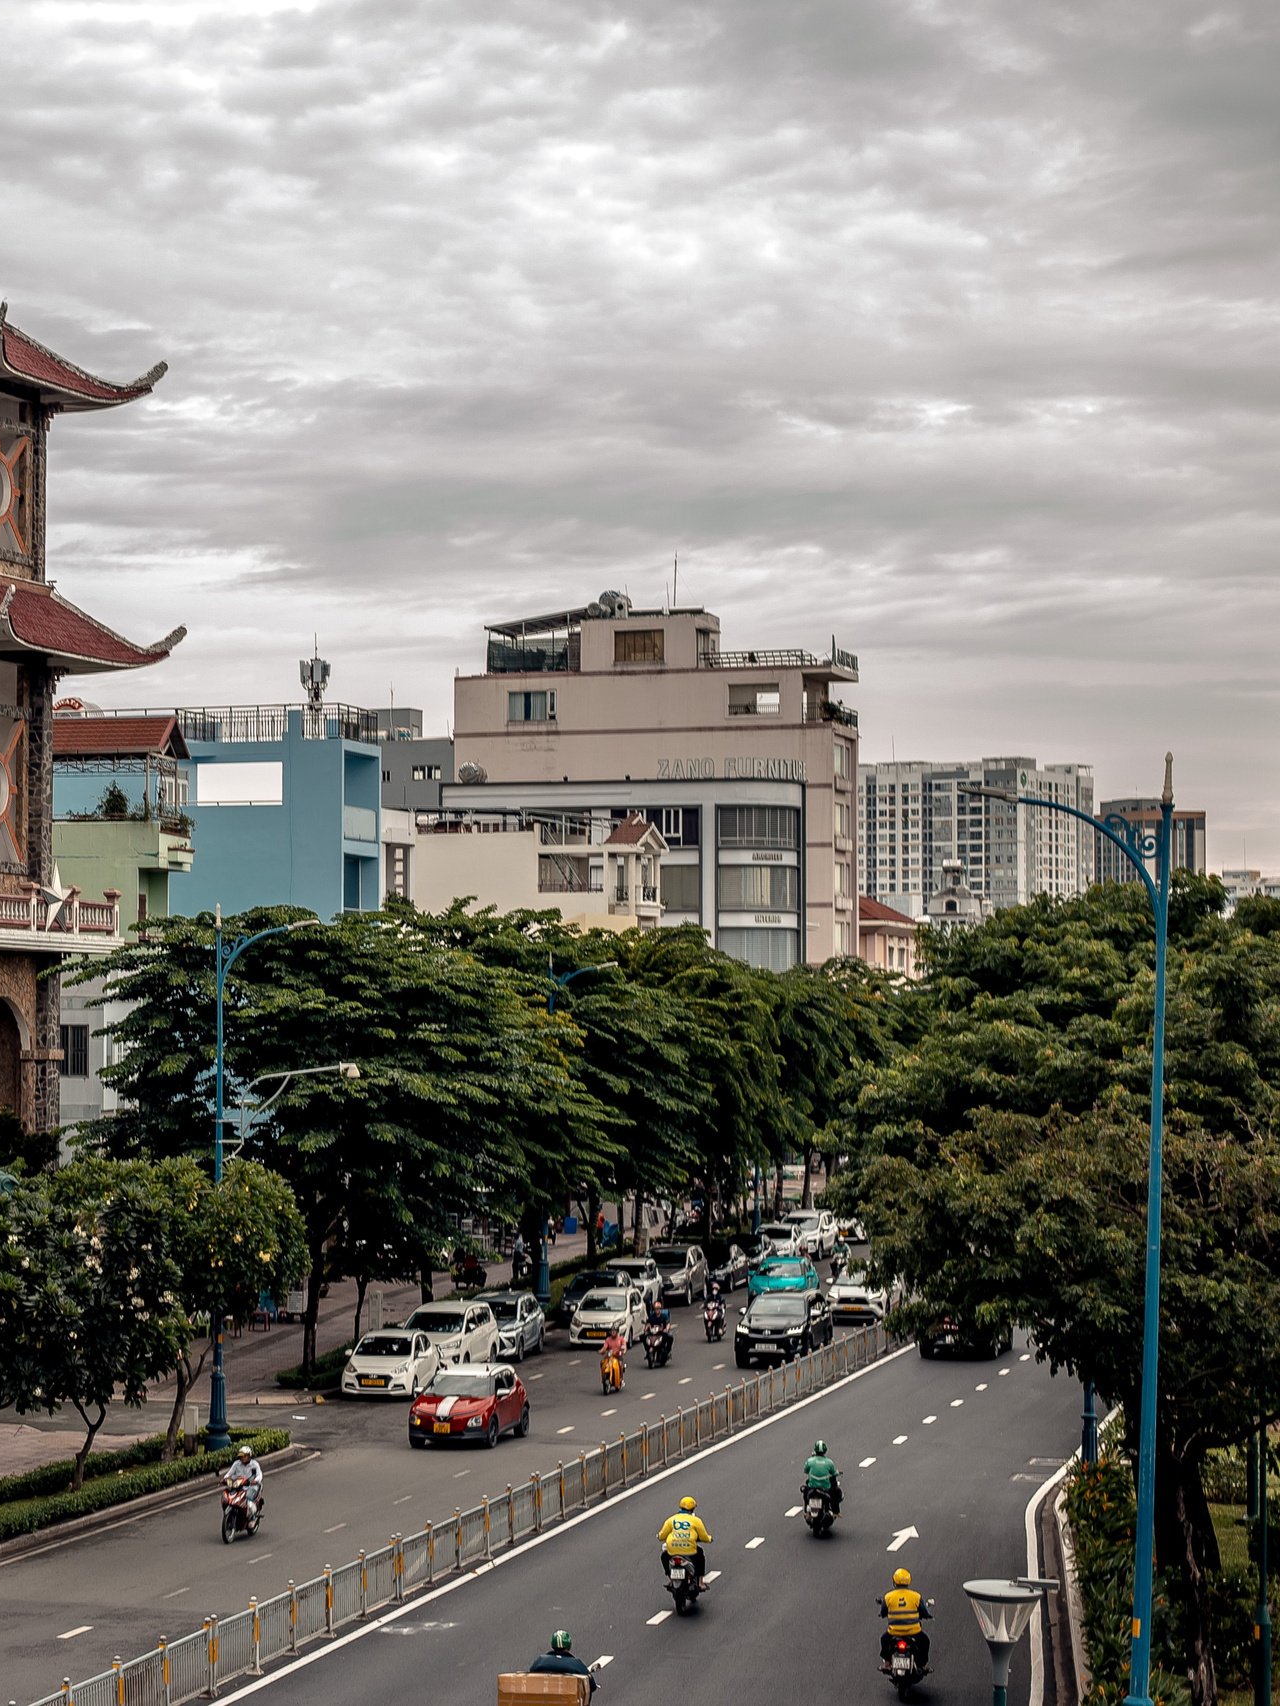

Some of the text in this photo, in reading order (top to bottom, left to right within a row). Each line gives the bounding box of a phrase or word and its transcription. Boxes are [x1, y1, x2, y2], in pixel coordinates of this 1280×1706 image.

[657, 757, 806, 782] ZANO FURNITURE
[673, 1519, 691, 1530] be
